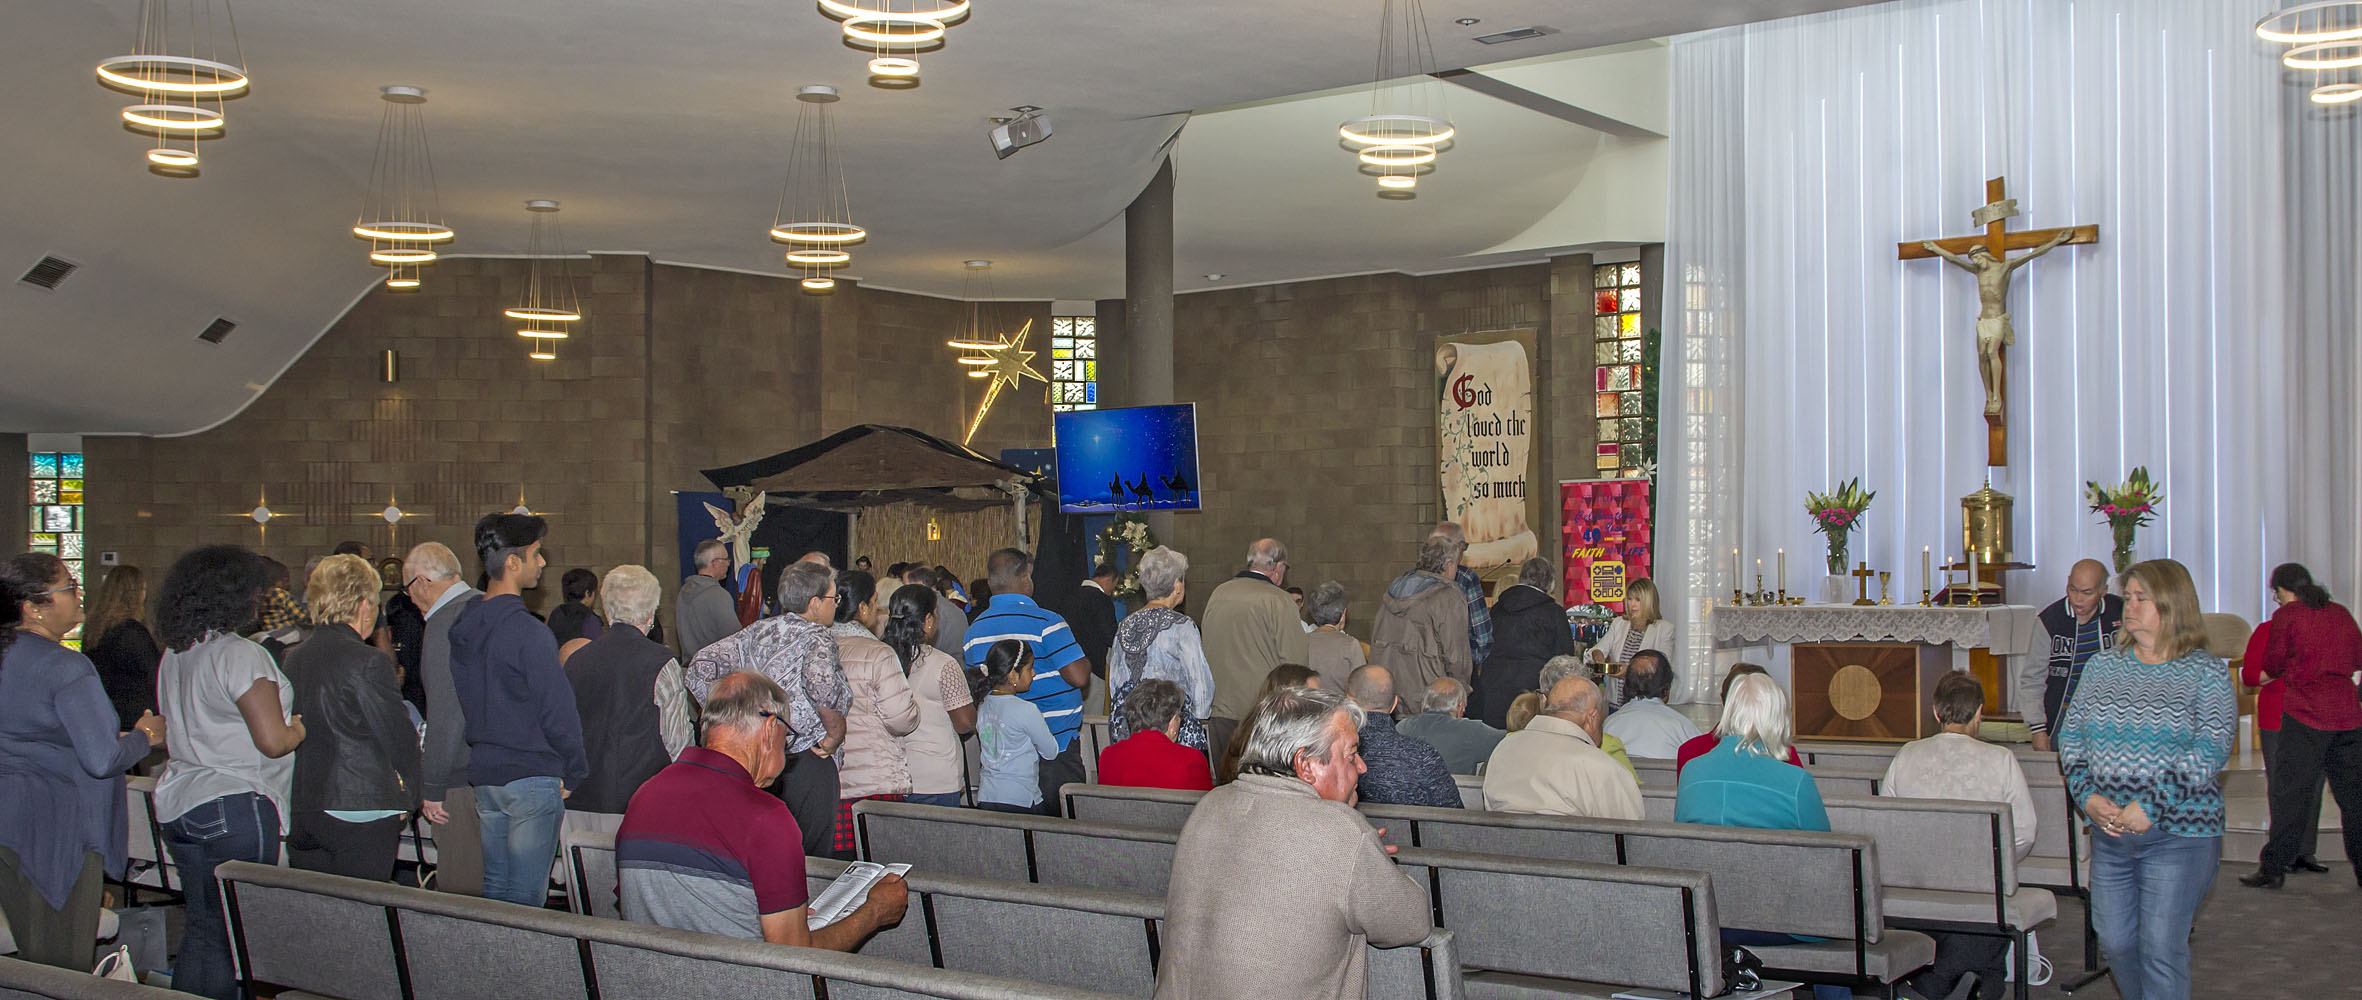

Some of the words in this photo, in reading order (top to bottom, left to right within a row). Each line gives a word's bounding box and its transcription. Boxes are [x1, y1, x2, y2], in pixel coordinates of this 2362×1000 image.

[1452, 372, 1492, 412] God
[1467, 412, 1502, 438] loved
[1507, 409, 1526, 436] the
[1471, 441, 1509, 468] world
[1473, 481, 1489, 499] so
[1493, 473, 1526, 499] much
[1582, 527, 1602, 542] 40
[1571, 547, 1605, 559] FAITH
[1622, 546, 1646, 557] LIFE
